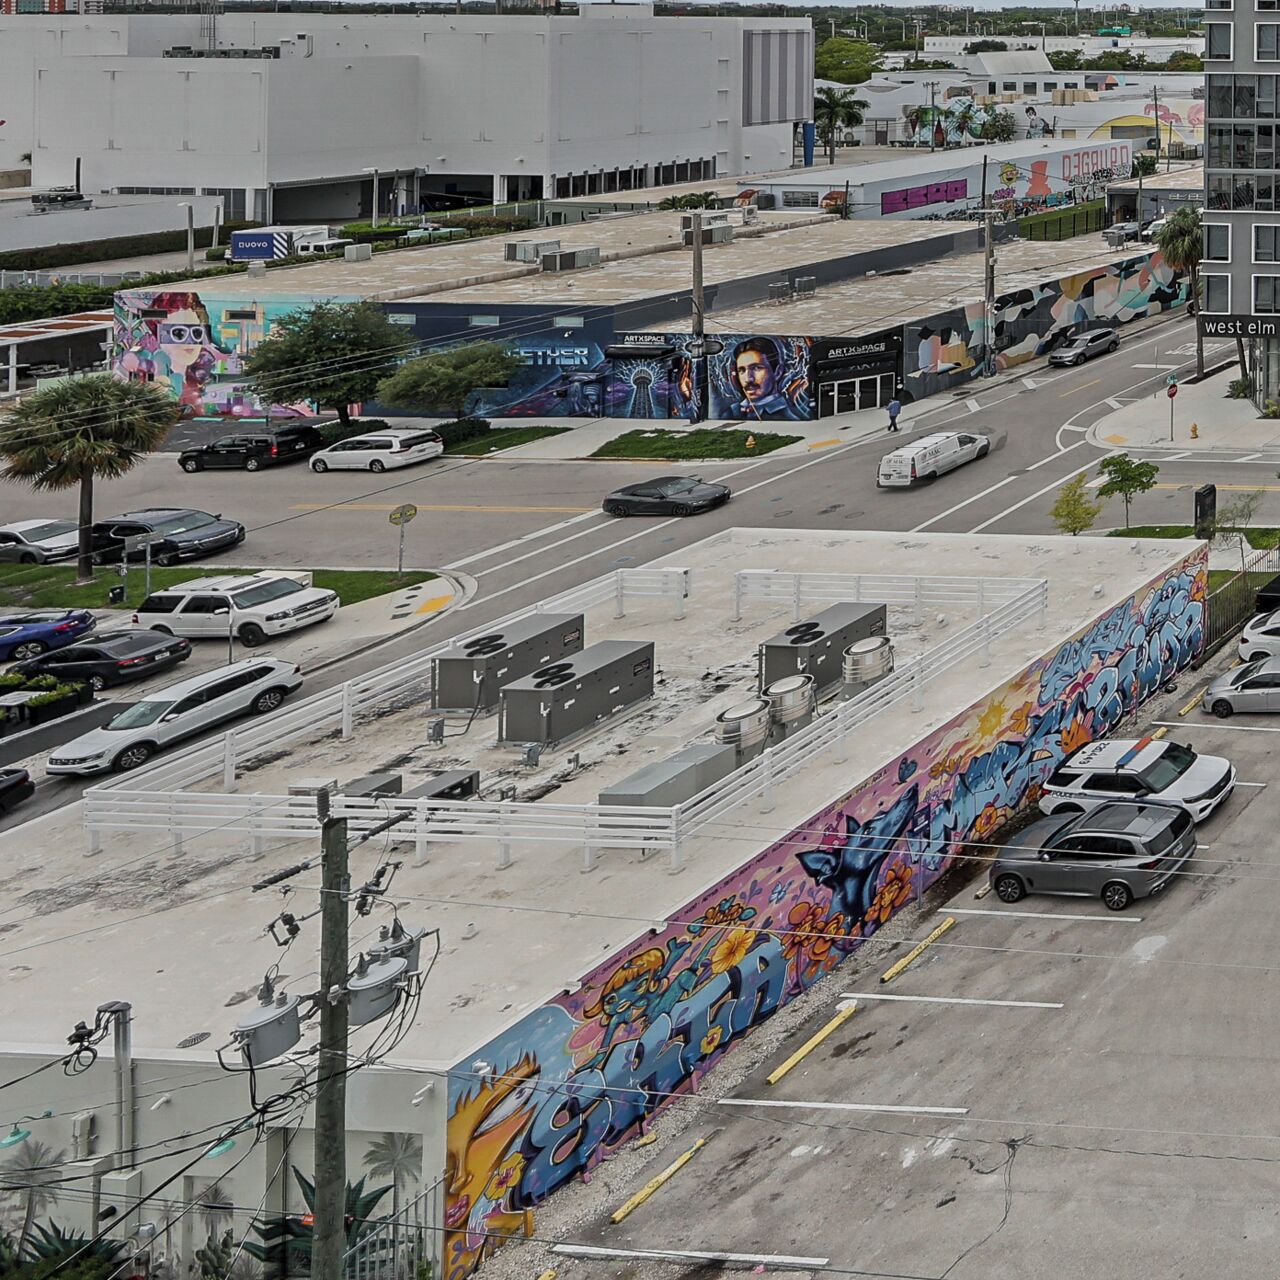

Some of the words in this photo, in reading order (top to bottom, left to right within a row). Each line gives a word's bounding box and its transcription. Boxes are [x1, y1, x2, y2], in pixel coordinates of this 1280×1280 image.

[1205, 320, 1242, 334] west
[1248, 320, 1275, 335] elm
[1051, 790, 1074, 799] POLICE
